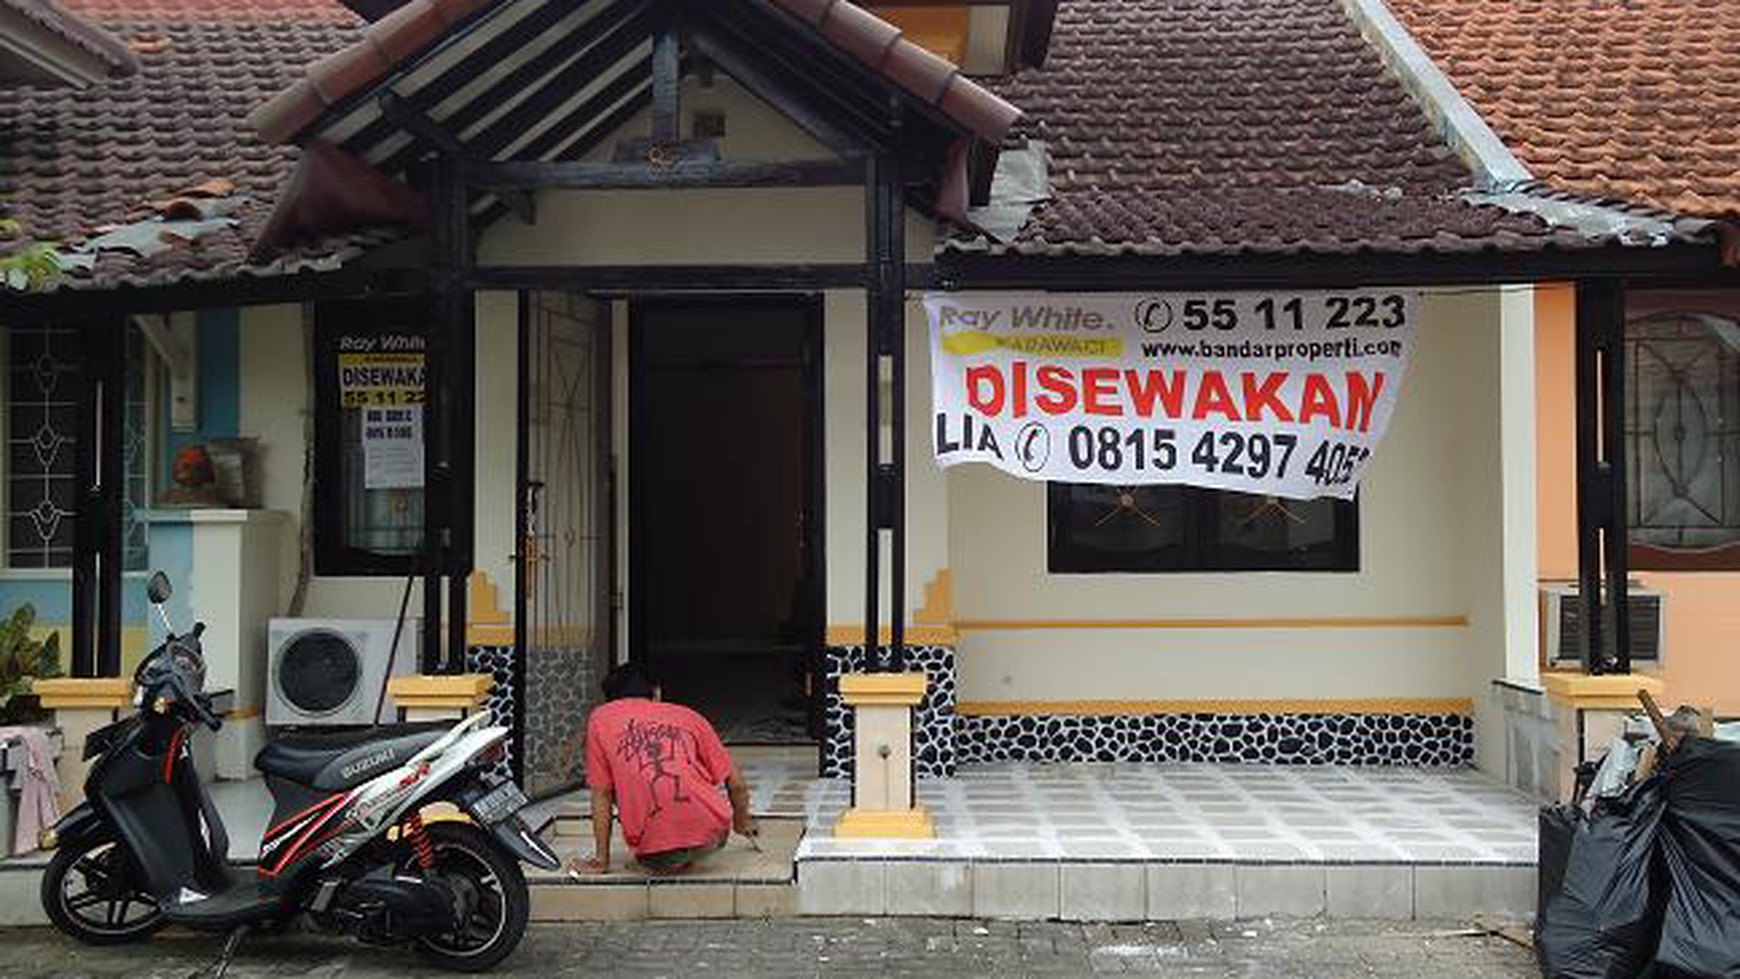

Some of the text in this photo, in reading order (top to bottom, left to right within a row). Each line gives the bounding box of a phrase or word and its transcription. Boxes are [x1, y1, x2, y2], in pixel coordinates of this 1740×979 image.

[941, 305, 1000, 331] Ray
[1183, 295, 1405, 330] 55 11 223
[340, 336, 376, 352] Ray
[344, 390, 368, 405] 55
[376, 390, 395, 405] 11
[966, 361, 1384, 433] DISEWAKAN
[936, 412, 1004, 461] LIA
[1068, 425, 1177, 471] 0815
[1192, 431, 1298, 479] 4297
[341, 748, 396, 779] SUZUKI
